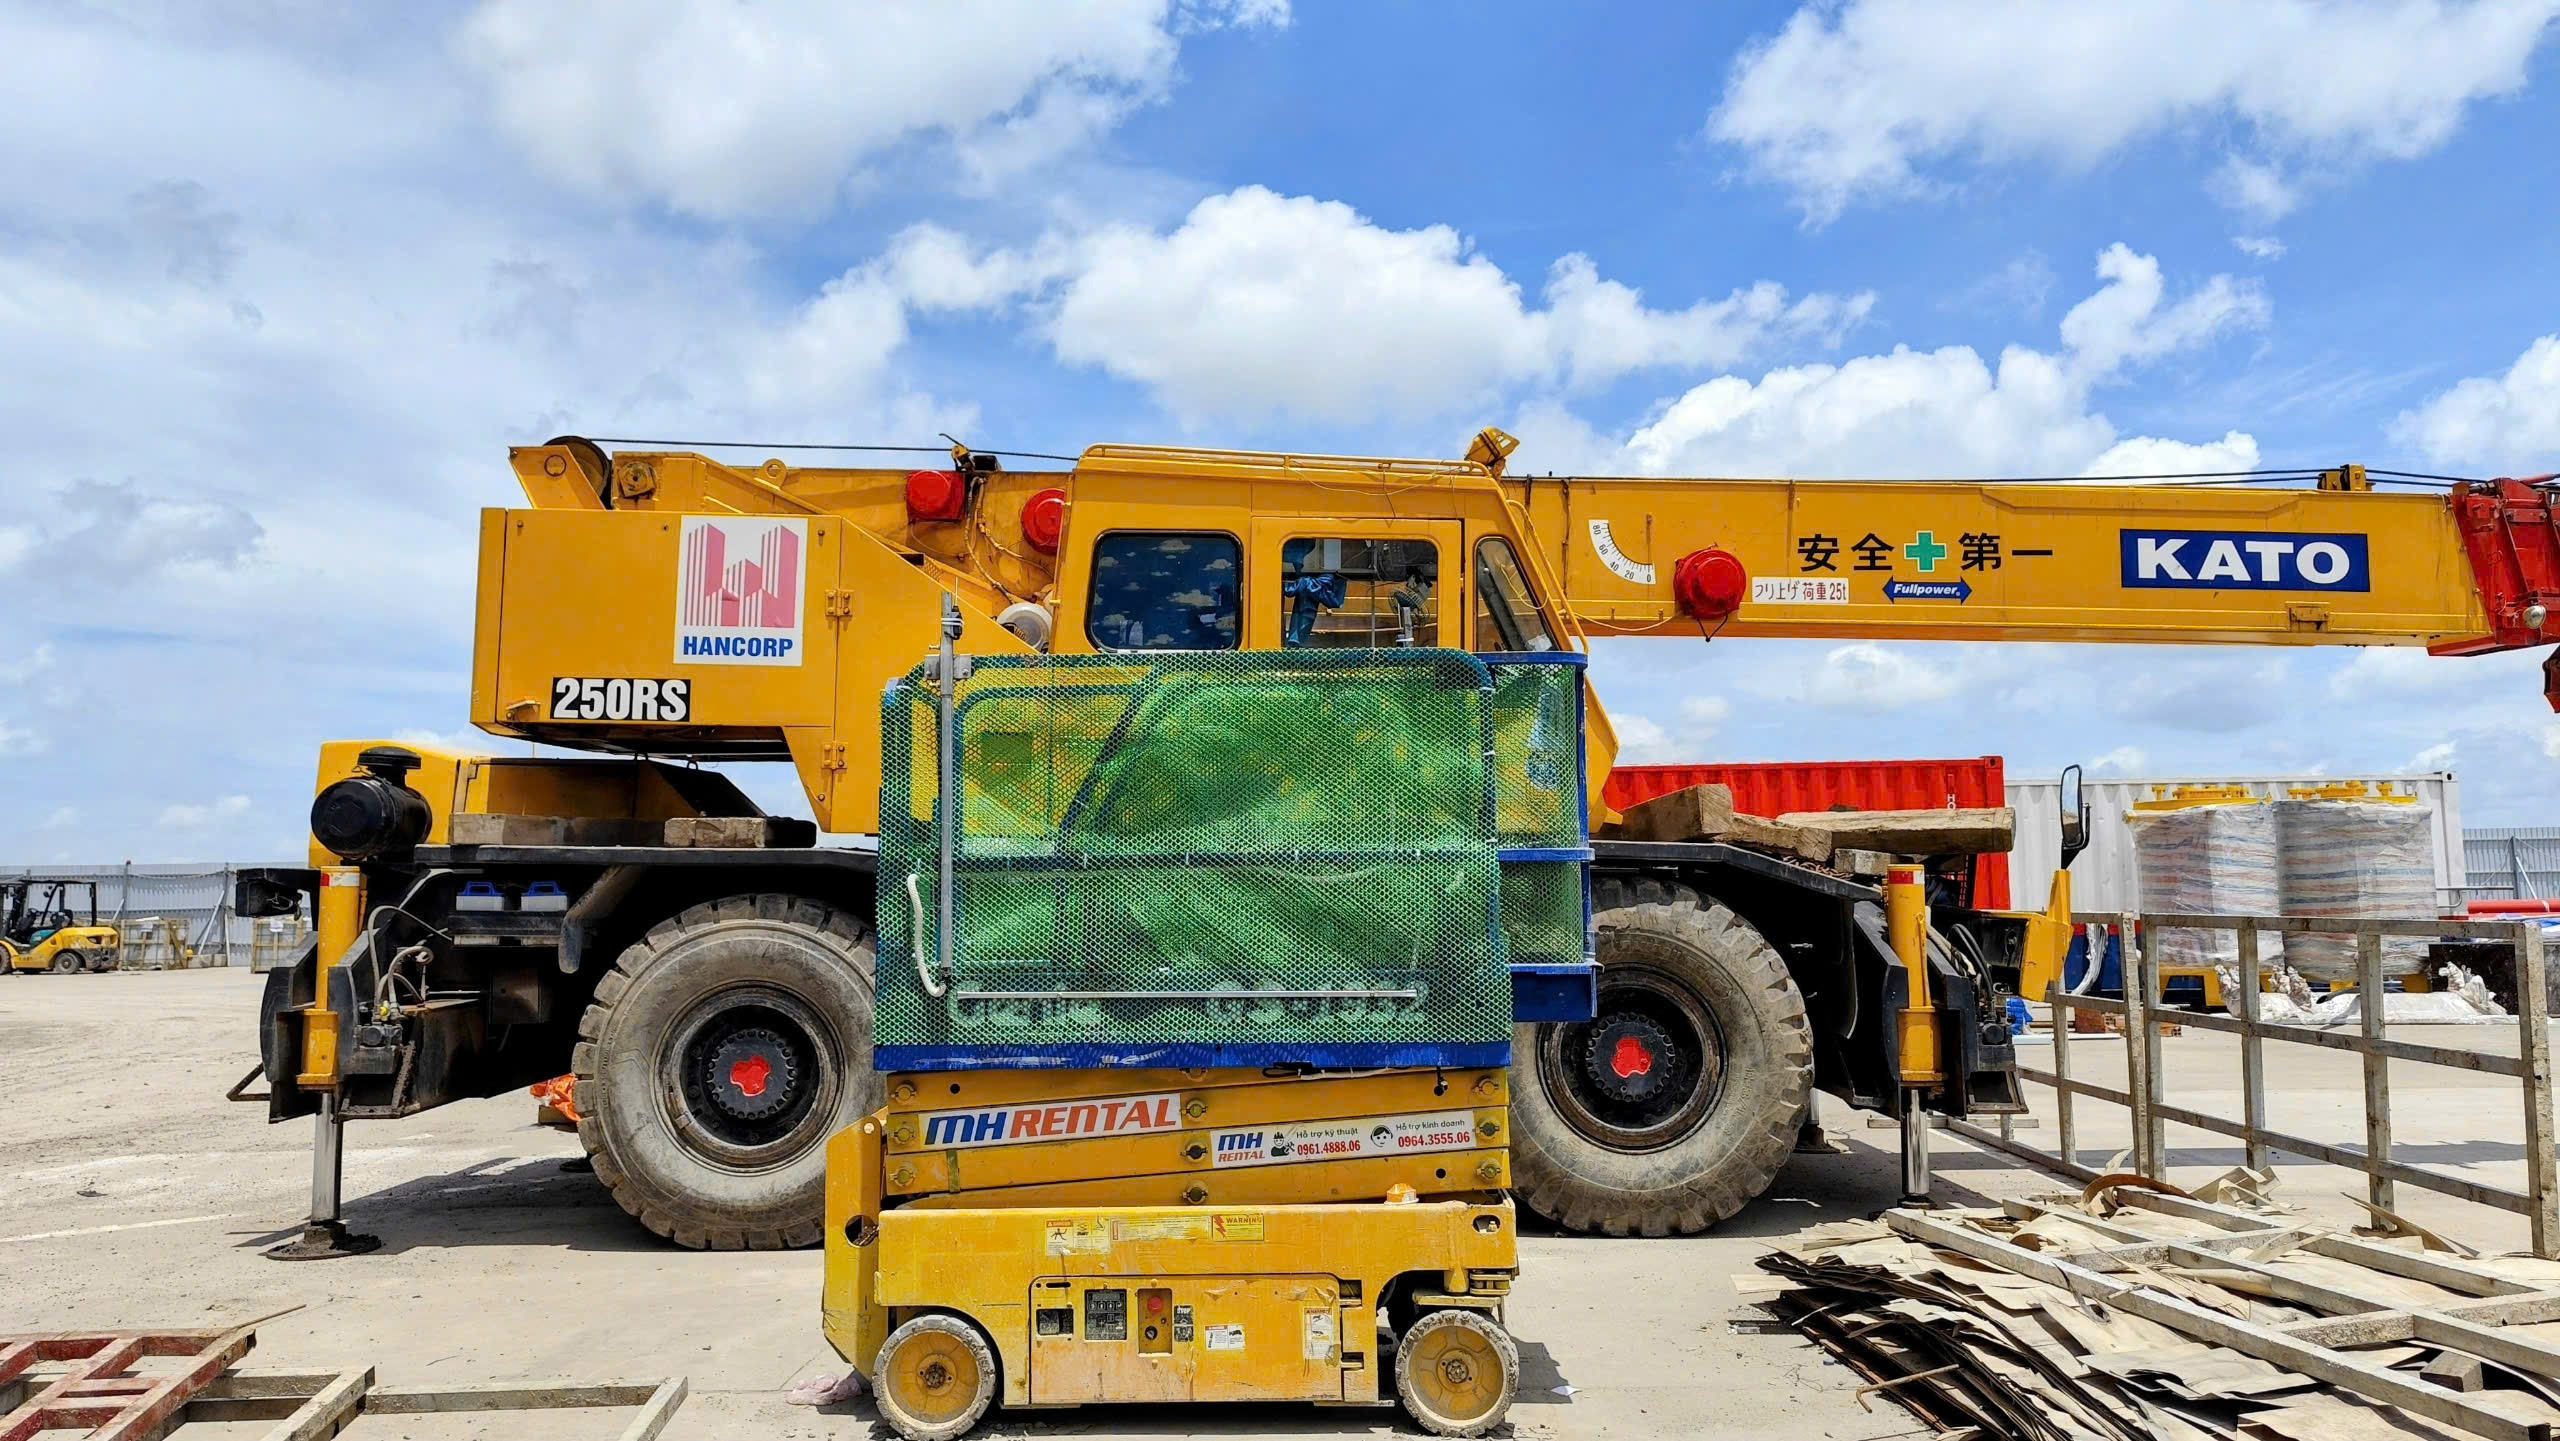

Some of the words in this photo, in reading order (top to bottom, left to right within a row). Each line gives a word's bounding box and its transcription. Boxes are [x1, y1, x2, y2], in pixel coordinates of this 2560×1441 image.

[1592, 524, 1602, 536] 80
[1598, 543, 1609, 556] 60
[1609, 561, 1620, 572] 40
[1624, 569, 1635, 580] 20
[1646, 573, 1652, 583] 0
[1797, 533, 1895, 572] 安全
[1958, 532, 2054, 572] 第一
[2136, 537, 2351, 585] KATO
[682, 635, 794, 658] HANCORP
[553, 677, 689, 722] 250RS
[1009, 1098, 1178, 1140] RENTAL
[1422, 1121, 1439, 1129] kinh
[1440, 1120, 1465, 1128] doanh
[1217, 1131, 1264, 1152] MH
[1297, 1139, 1361, 1156] 0961.4888.06
[1397, 1130, 1471, 1148] 0964.3555.06
[1217, 1150, 1266, 1163] RENTAL
